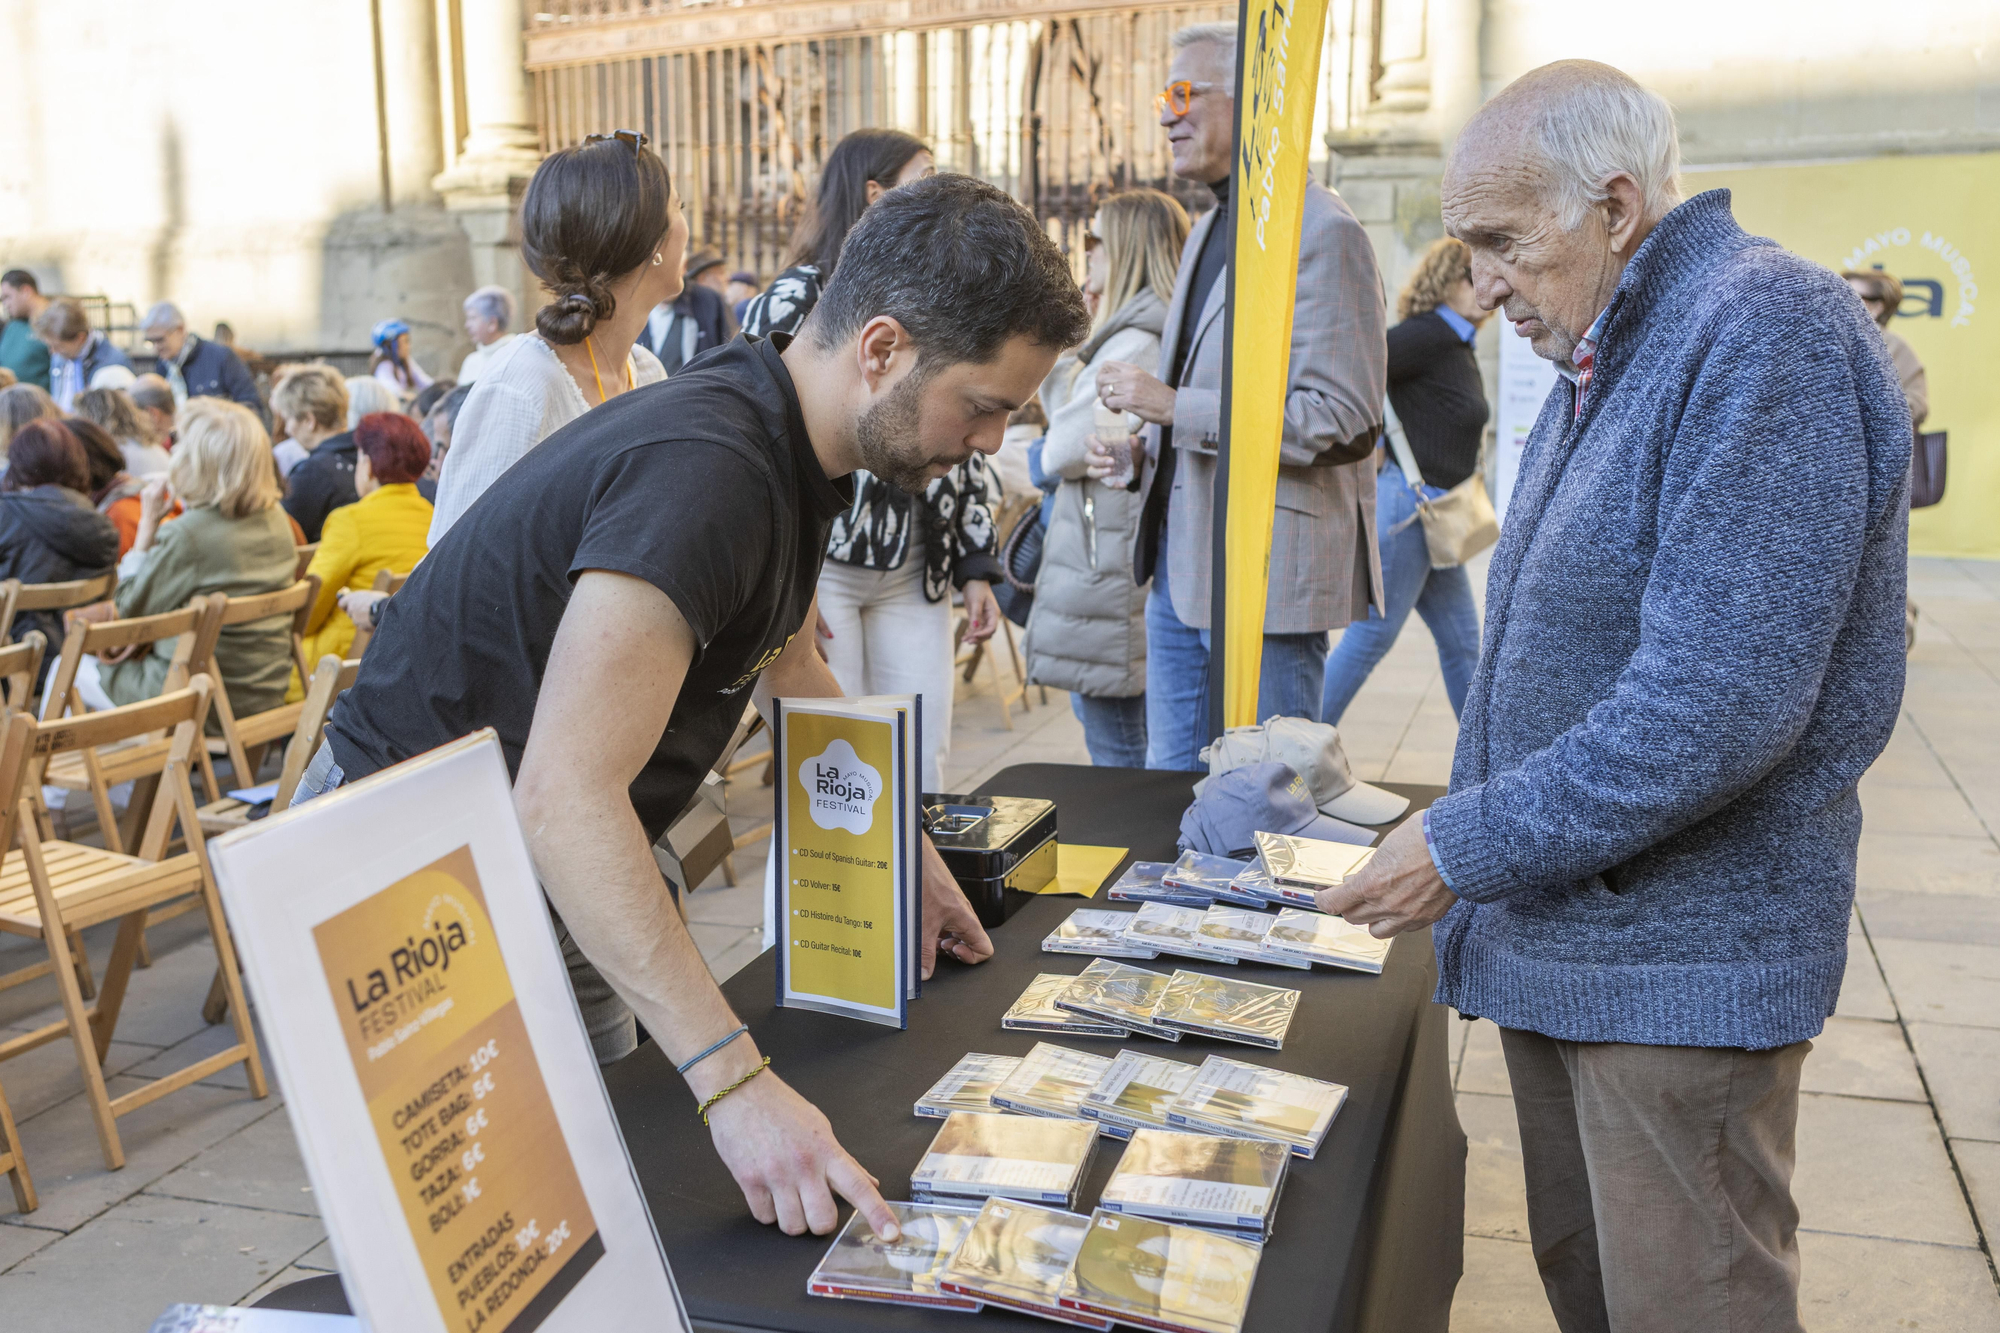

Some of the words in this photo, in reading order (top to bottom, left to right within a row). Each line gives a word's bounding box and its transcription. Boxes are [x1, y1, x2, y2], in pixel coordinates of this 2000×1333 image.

[1256, 126, 1280, 252] Pablo
[1842, 226, 1912, 271] MAYO
[1920, 230, 1979, 329] MUSICAL
[817, 763, 839, 779] La
[817, 779, 865, 802] Rioja
[843, 771, 857, 781] MAYO
[859, 774, 873, 801] MUSICAL
[817, 799, 865, 815] FESTIVAL
[800, 849, 808, 857] CD
[810, 850, 824, 859] Soul
[825, 851, 831, 860] of
[832, 853, 854, 864] Spanish
[856, 857, 876, 868] Guitar:
[877, 861, 888, 869] 20€
[800, 879, 809, 887] CD
[810, 880, 831, 890] Volver:
[832, 884, 841, 892] 15€
[800, 909, 809, 918] CD
[811, 911, 834, 921] Histoire
[835, 916, 842, 924] du
[843, 917, 862, 928] Tango:
[863, 921, 873, 929] 15€
[800, 940, 809, 948] CD
[811, 941, 830, 950] Guitar
[831, 944, 851, 956] Recital:
[853, 949, 861, 958] 10€
[346, 968, 390, 1014] La
[390, 920, 467, 986] Rioja
[358, 973, 447, 1041] FESTIVAL
[391, 1064, 470, 1131] CAMISETA:
[469, 1038, 499, 1073] 10€
[401, 1116, 438, 1155] TOTE
[438, 1092, 472, 1127] BAG:
[472, 1072, 495, 1100] 5€
[410, 1129, 466, 1182] GORRA:
[465, 1108, 489, 1137] 6€
[419, 1164, 462, 1206] TAZA:
[461, 1142, 485, 1171] 6€
[428, 1193, 465, 1234] BOLI:
[461, 1177, 482, 1204] 1€
[447, 1211, 515, 1285] ENTRADAS
[457, 1243, 519, 1310] PUEBLOS:
[514, 1218, 540, 1250] 10€
[466, 1309, 486, 1333] LA
[484, 1246, 549, 1316] REDONDA:
[545, 1219, 571, 1255] 20€
